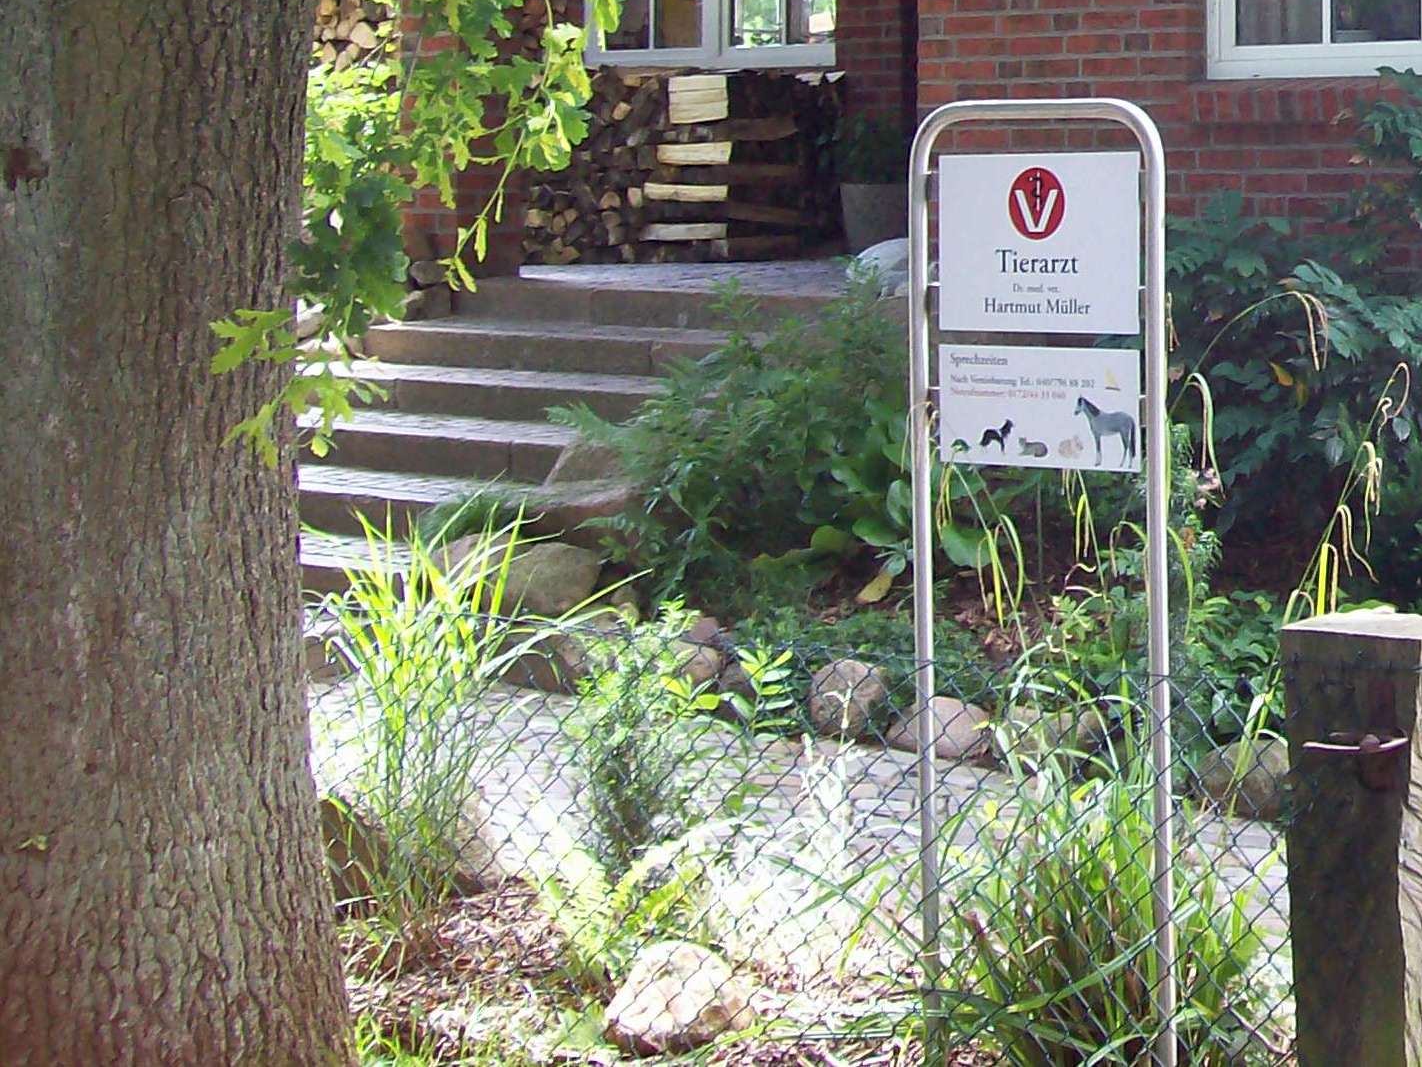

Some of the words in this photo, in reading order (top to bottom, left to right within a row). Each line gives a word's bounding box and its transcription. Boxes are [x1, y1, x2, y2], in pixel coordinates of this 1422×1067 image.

[1014, 189, 1059, 233] V
[995, 248, 1080, 274] Tierarzt
[984, 297, 1041, 314] Hartmut
[1045, 298, 1091, 315] Müller
[950, 353, 1008, 368] Sprechzeiten
